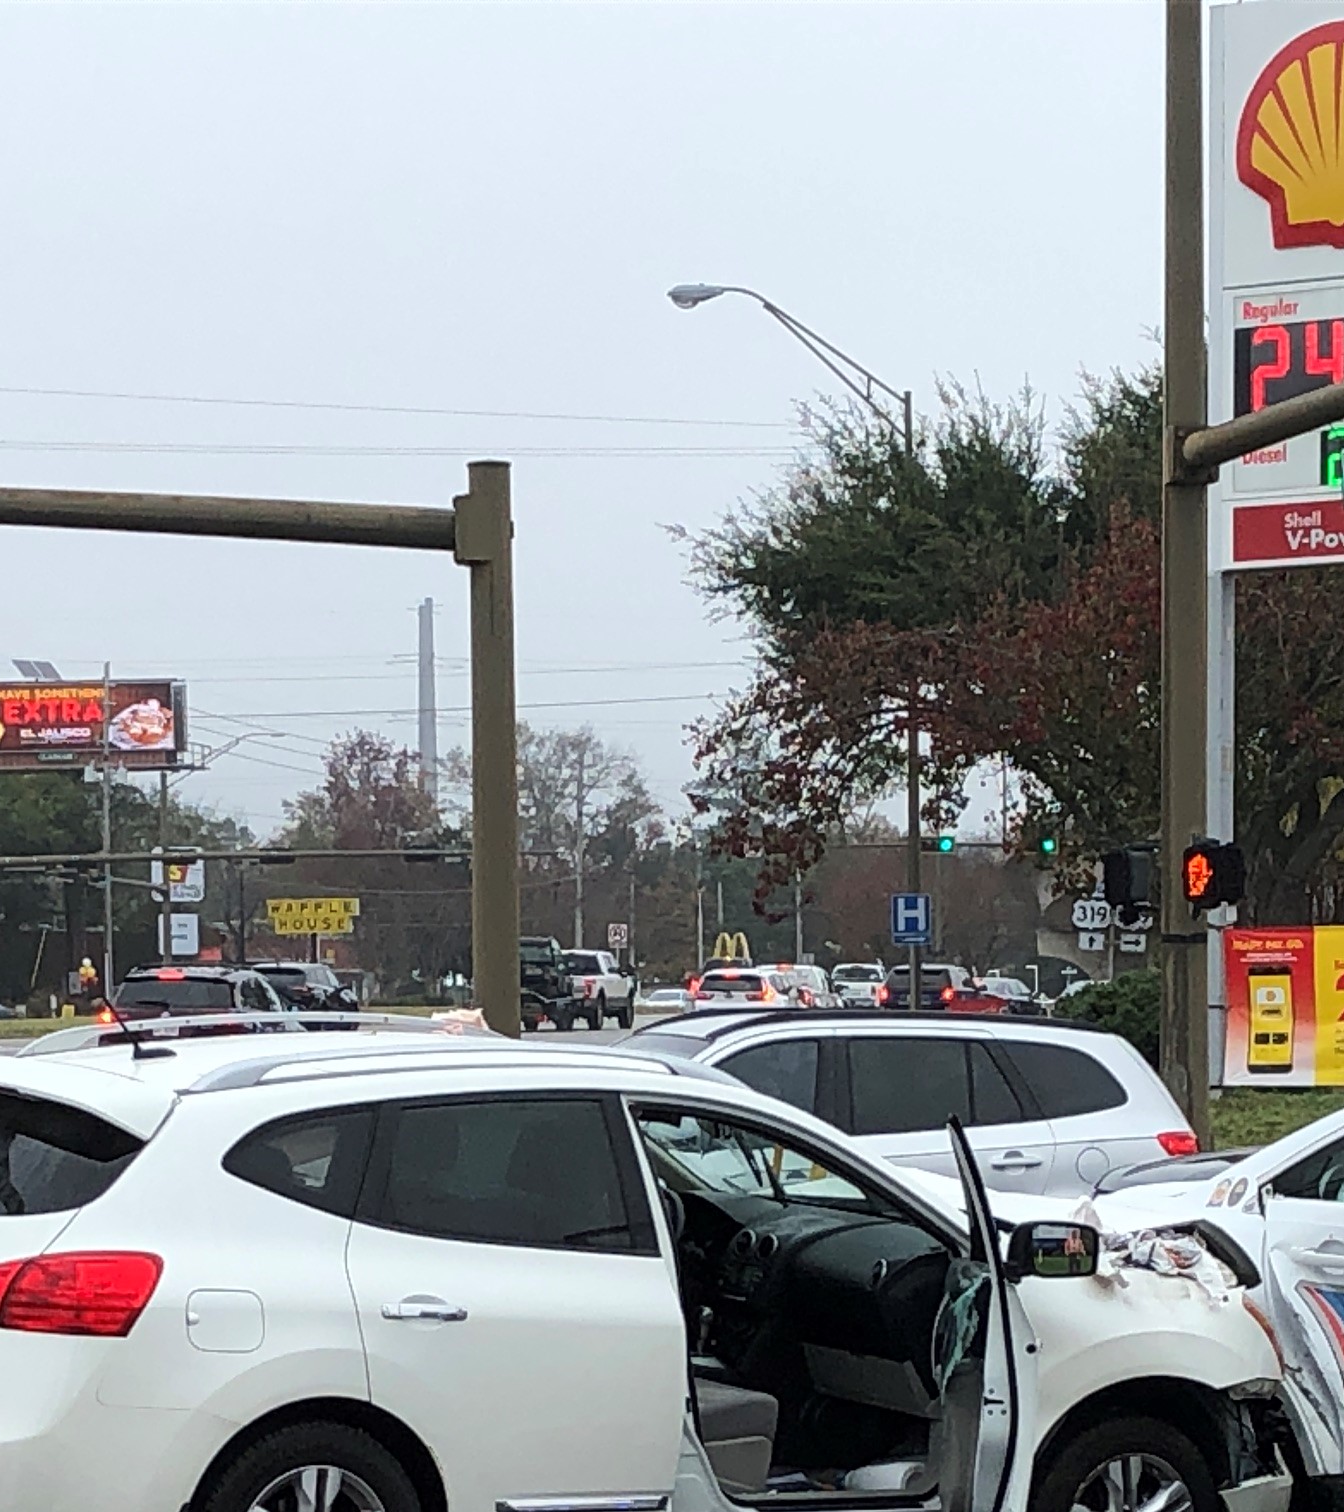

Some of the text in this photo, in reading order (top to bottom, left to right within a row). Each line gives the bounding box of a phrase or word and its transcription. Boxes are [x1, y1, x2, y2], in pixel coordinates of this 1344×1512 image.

[1242, 298, 1299, 323] Regular
[1284, 510, 1321, 529] Shell
[3, 699, 103, 725] EXTRA
[279, 918, 346, 930] HOUSE
[897, 897, 927, 932] H
[1076, 905, 1107, 921] 319
